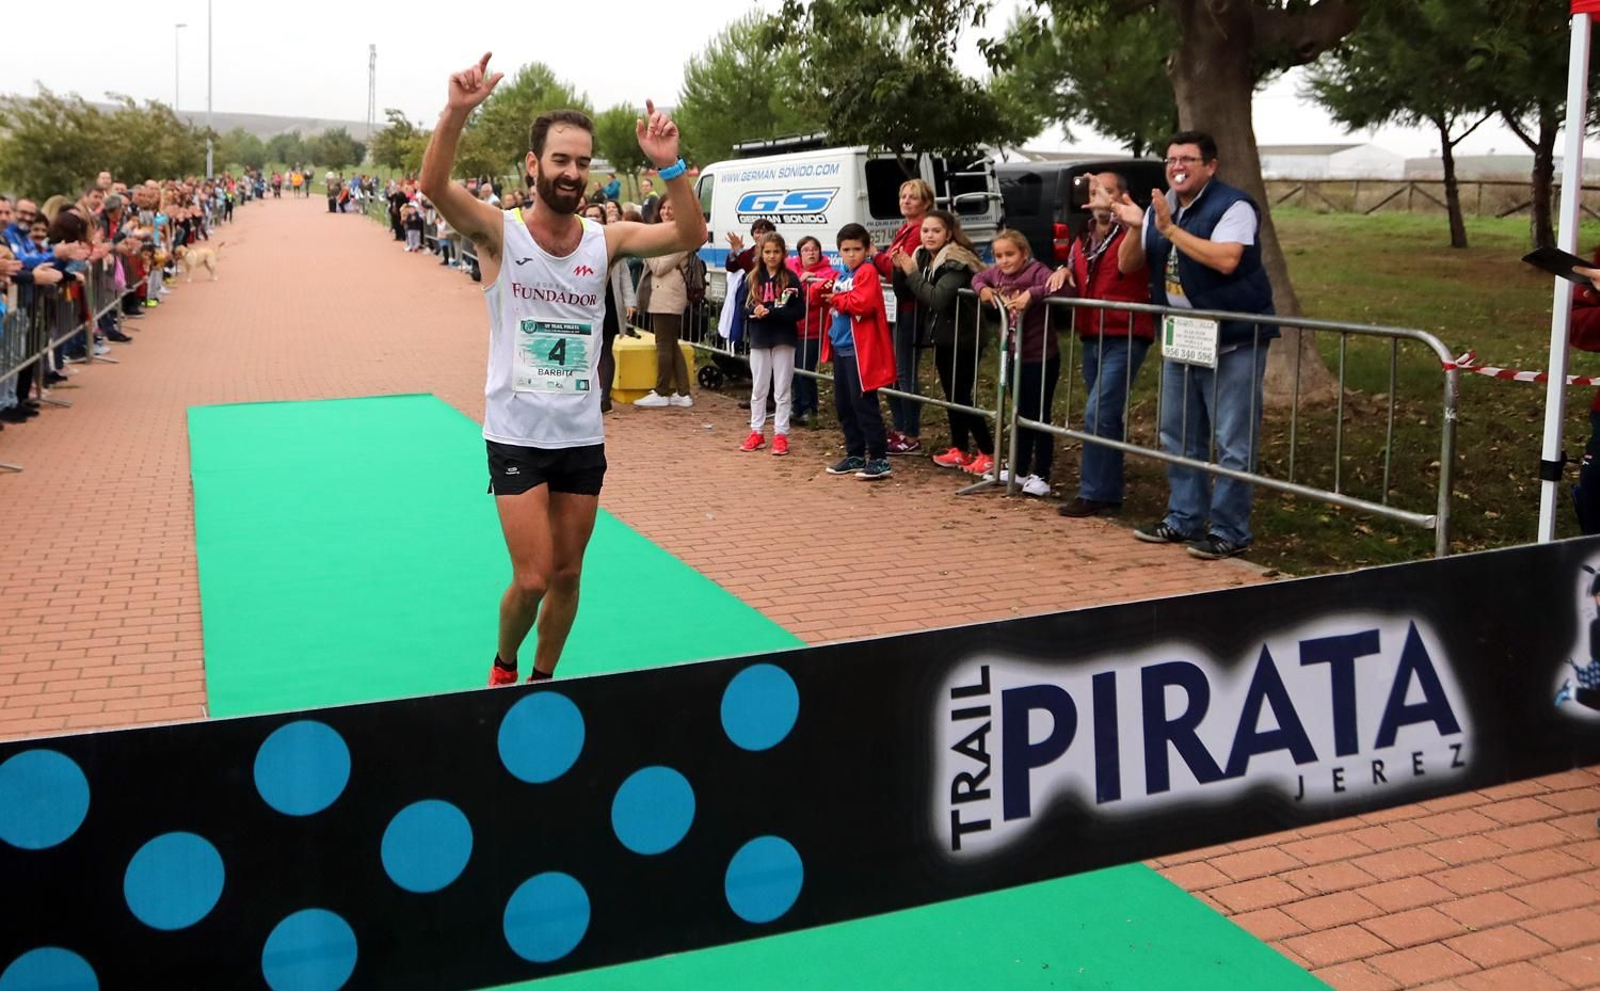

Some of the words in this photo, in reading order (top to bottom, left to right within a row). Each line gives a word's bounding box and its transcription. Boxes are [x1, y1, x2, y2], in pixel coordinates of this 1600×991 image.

[778, 163, 840, 178] SONIDO.COM
[735, 187, 840, 214] GS
[783, 214, 827, 224] SONIDO
[512, 282, 597, 306] FUNDADOR
[547, 338, 567, 366] 4
[1002, 619, 1462, 822] PIRATA
[951, 665, 992, 851] TRAIL
[1295, 743, 1465, 801] JEREZ
